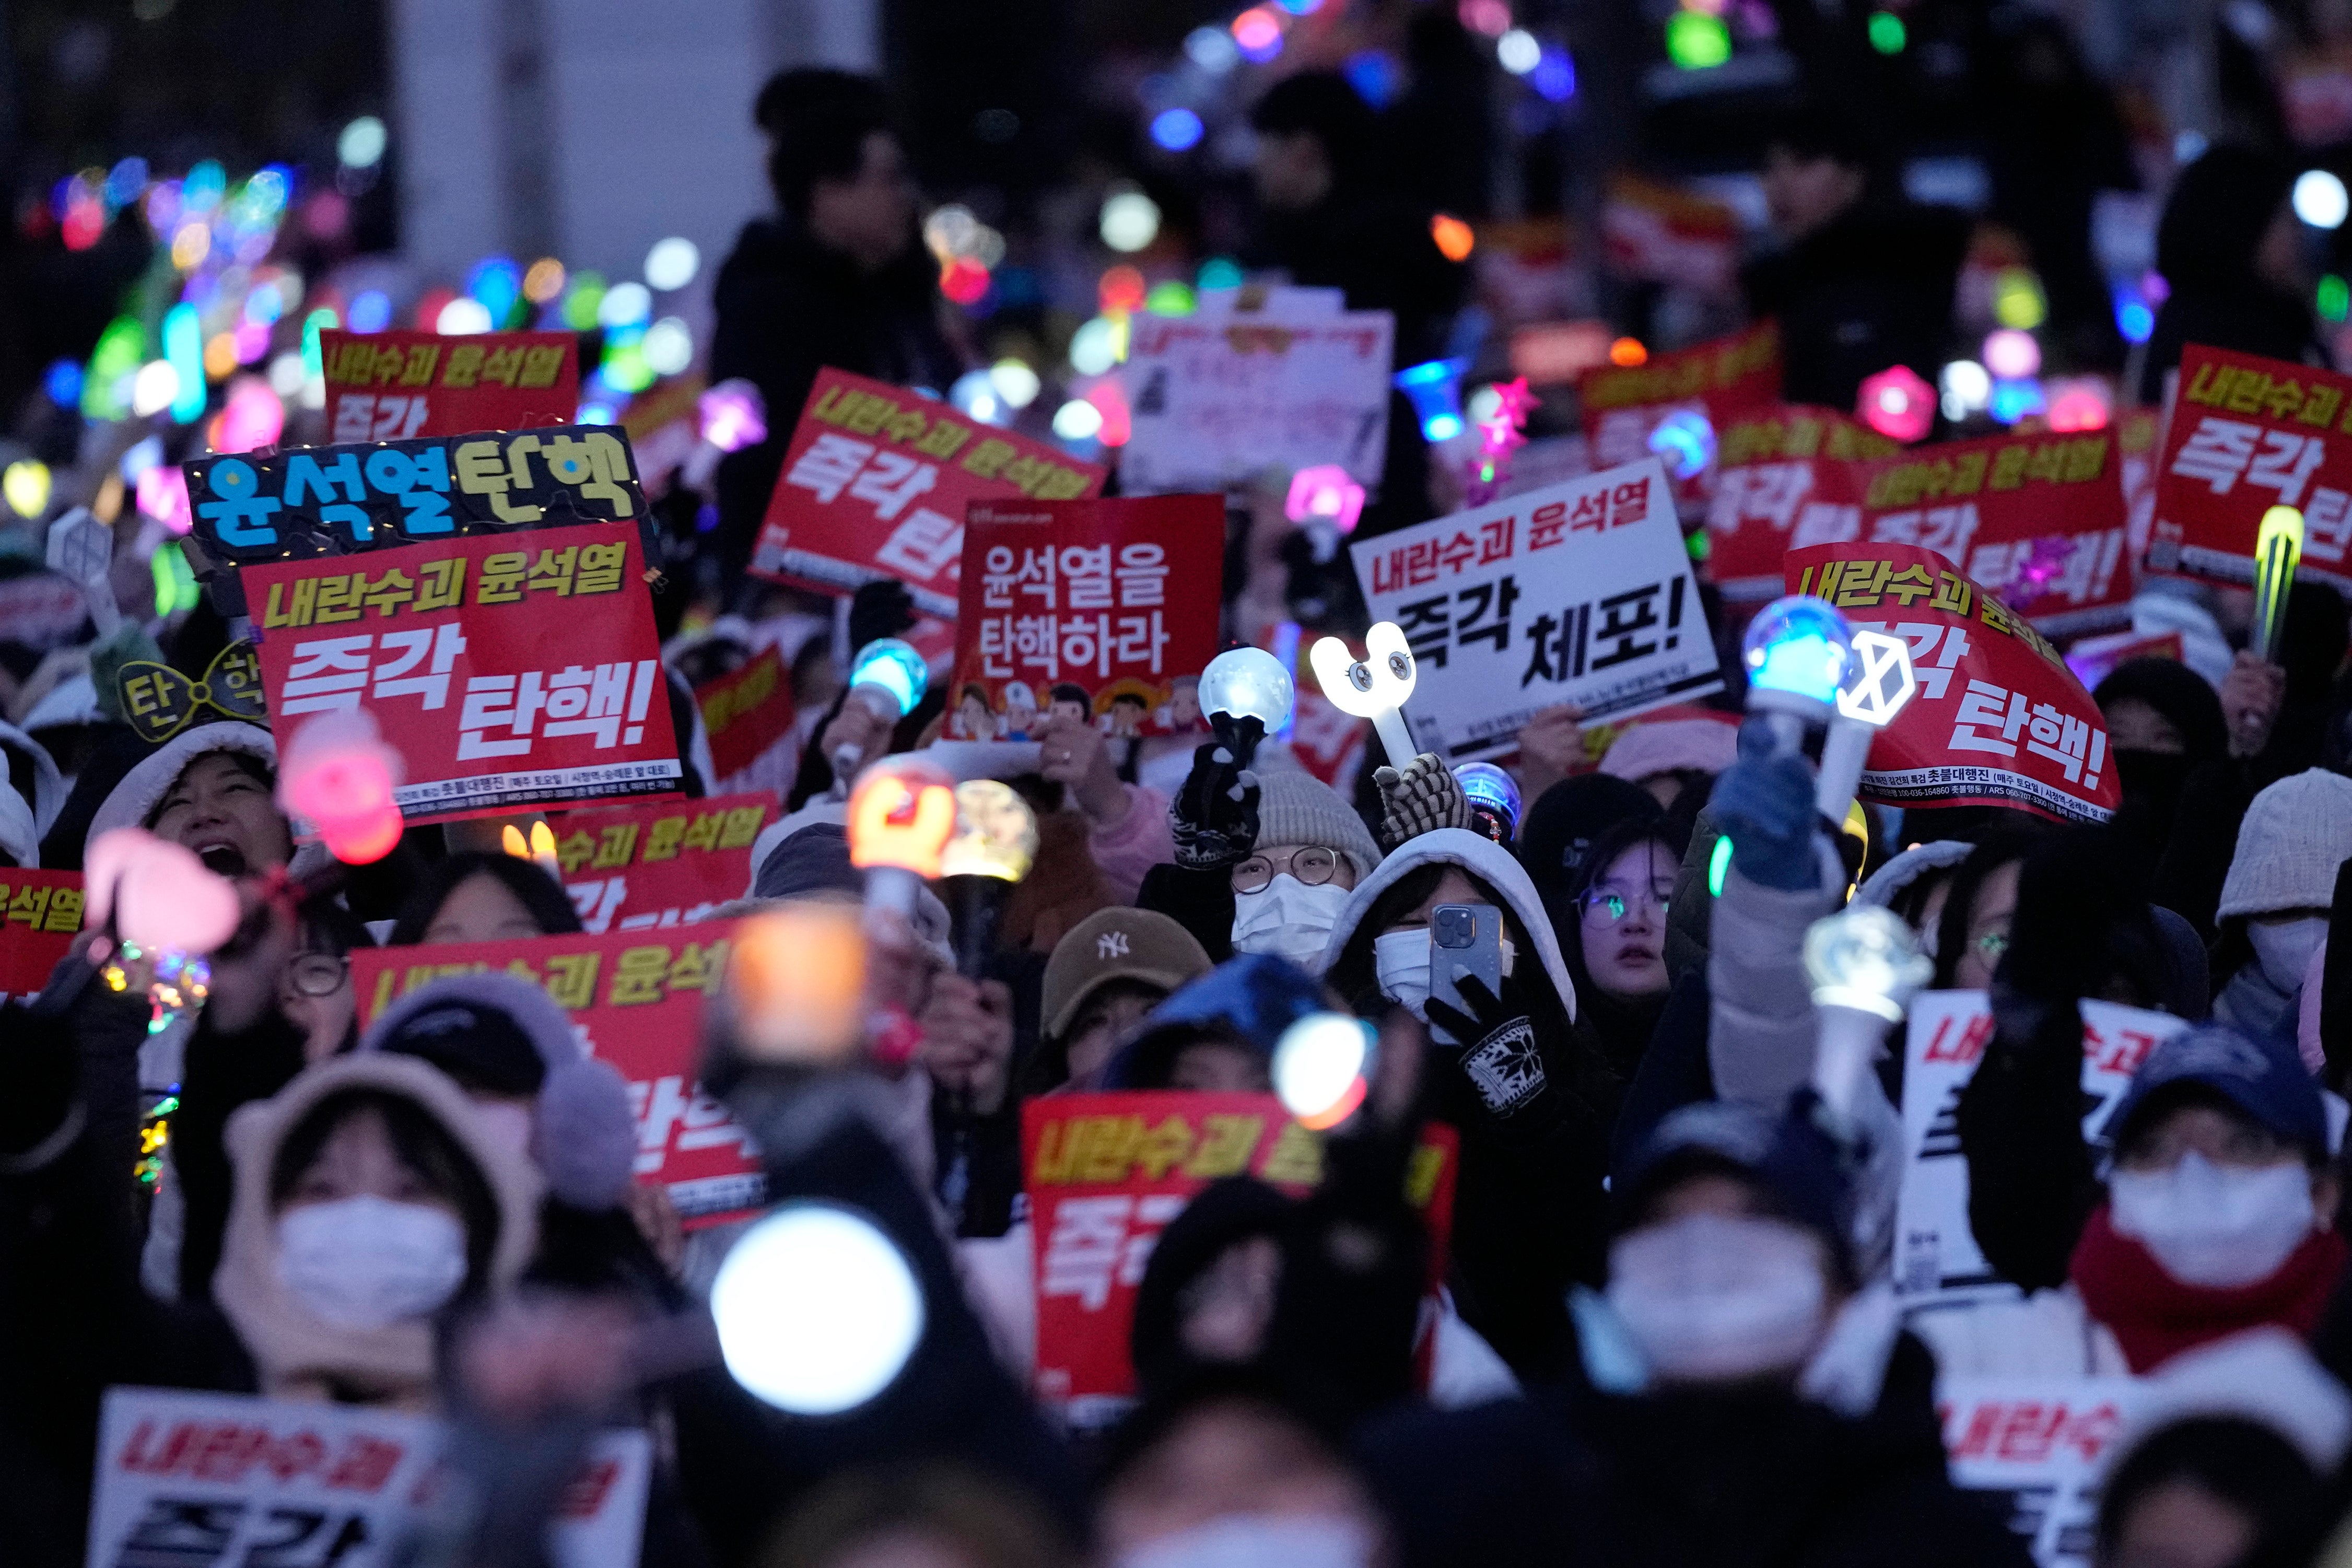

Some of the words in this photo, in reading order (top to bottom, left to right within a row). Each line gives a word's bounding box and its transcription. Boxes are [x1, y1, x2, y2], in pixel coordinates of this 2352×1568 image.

[327, 343, 440, 388] 내란수괴
[442, 342, 564, 388] 윤석열
[2186, 364, 2344, 428] 내란수괴
[812, 385, 972, 461] 내란수괴
[197, 445, 455, 548] 윤석열
[454, 431, 634, 524] 탄핵
[787, 431, 939, 521] 즉각
[2171, 417, 2326, 505] 즉각
[1372, 516, 1517, 596] 내란수괴
[1527, 476, 1651, 552] 윤석열
[263, 556, 469, 630] 내란수괴
[477, 541, 627, 605] 윤석열
[981, 542, 1169, 610] 윤석열을
[1798, 560, 1972, 616] 내란수괴
[979, 610, 1170, 679] 탄핵하라
[1398, 574, 1520, 669] 즉각
[1520, 576, 1686, 689] 체포!
[125, 671, 177, 729] 탄
[279, 622, 467, 717] 즉각
[456, 659, 657, 762] 탄핵!
[1947, 679, 2107, 791] 탄핵!
[1888, 775, 1910, 786] 김건희
[1910, 774, 1926, 785] 특검
[1927, 767, 1990, 782] 촛불대행진
[1993, 773, 2014, 786] (매주
[2016, 778, 2039, 794] 토요일
[1898, 786, 1950, 797] 100-036-164860
[1951, 785, 1982, 794] 촛불행동
[555, 823, 640, 873] 수괴
[642, 804, 766, 862] 윤석열
[0, 884, 85, 932] 석열
[609, 938, 729, 1007] 윤석
[1098, 931, 1130, 960] NY
